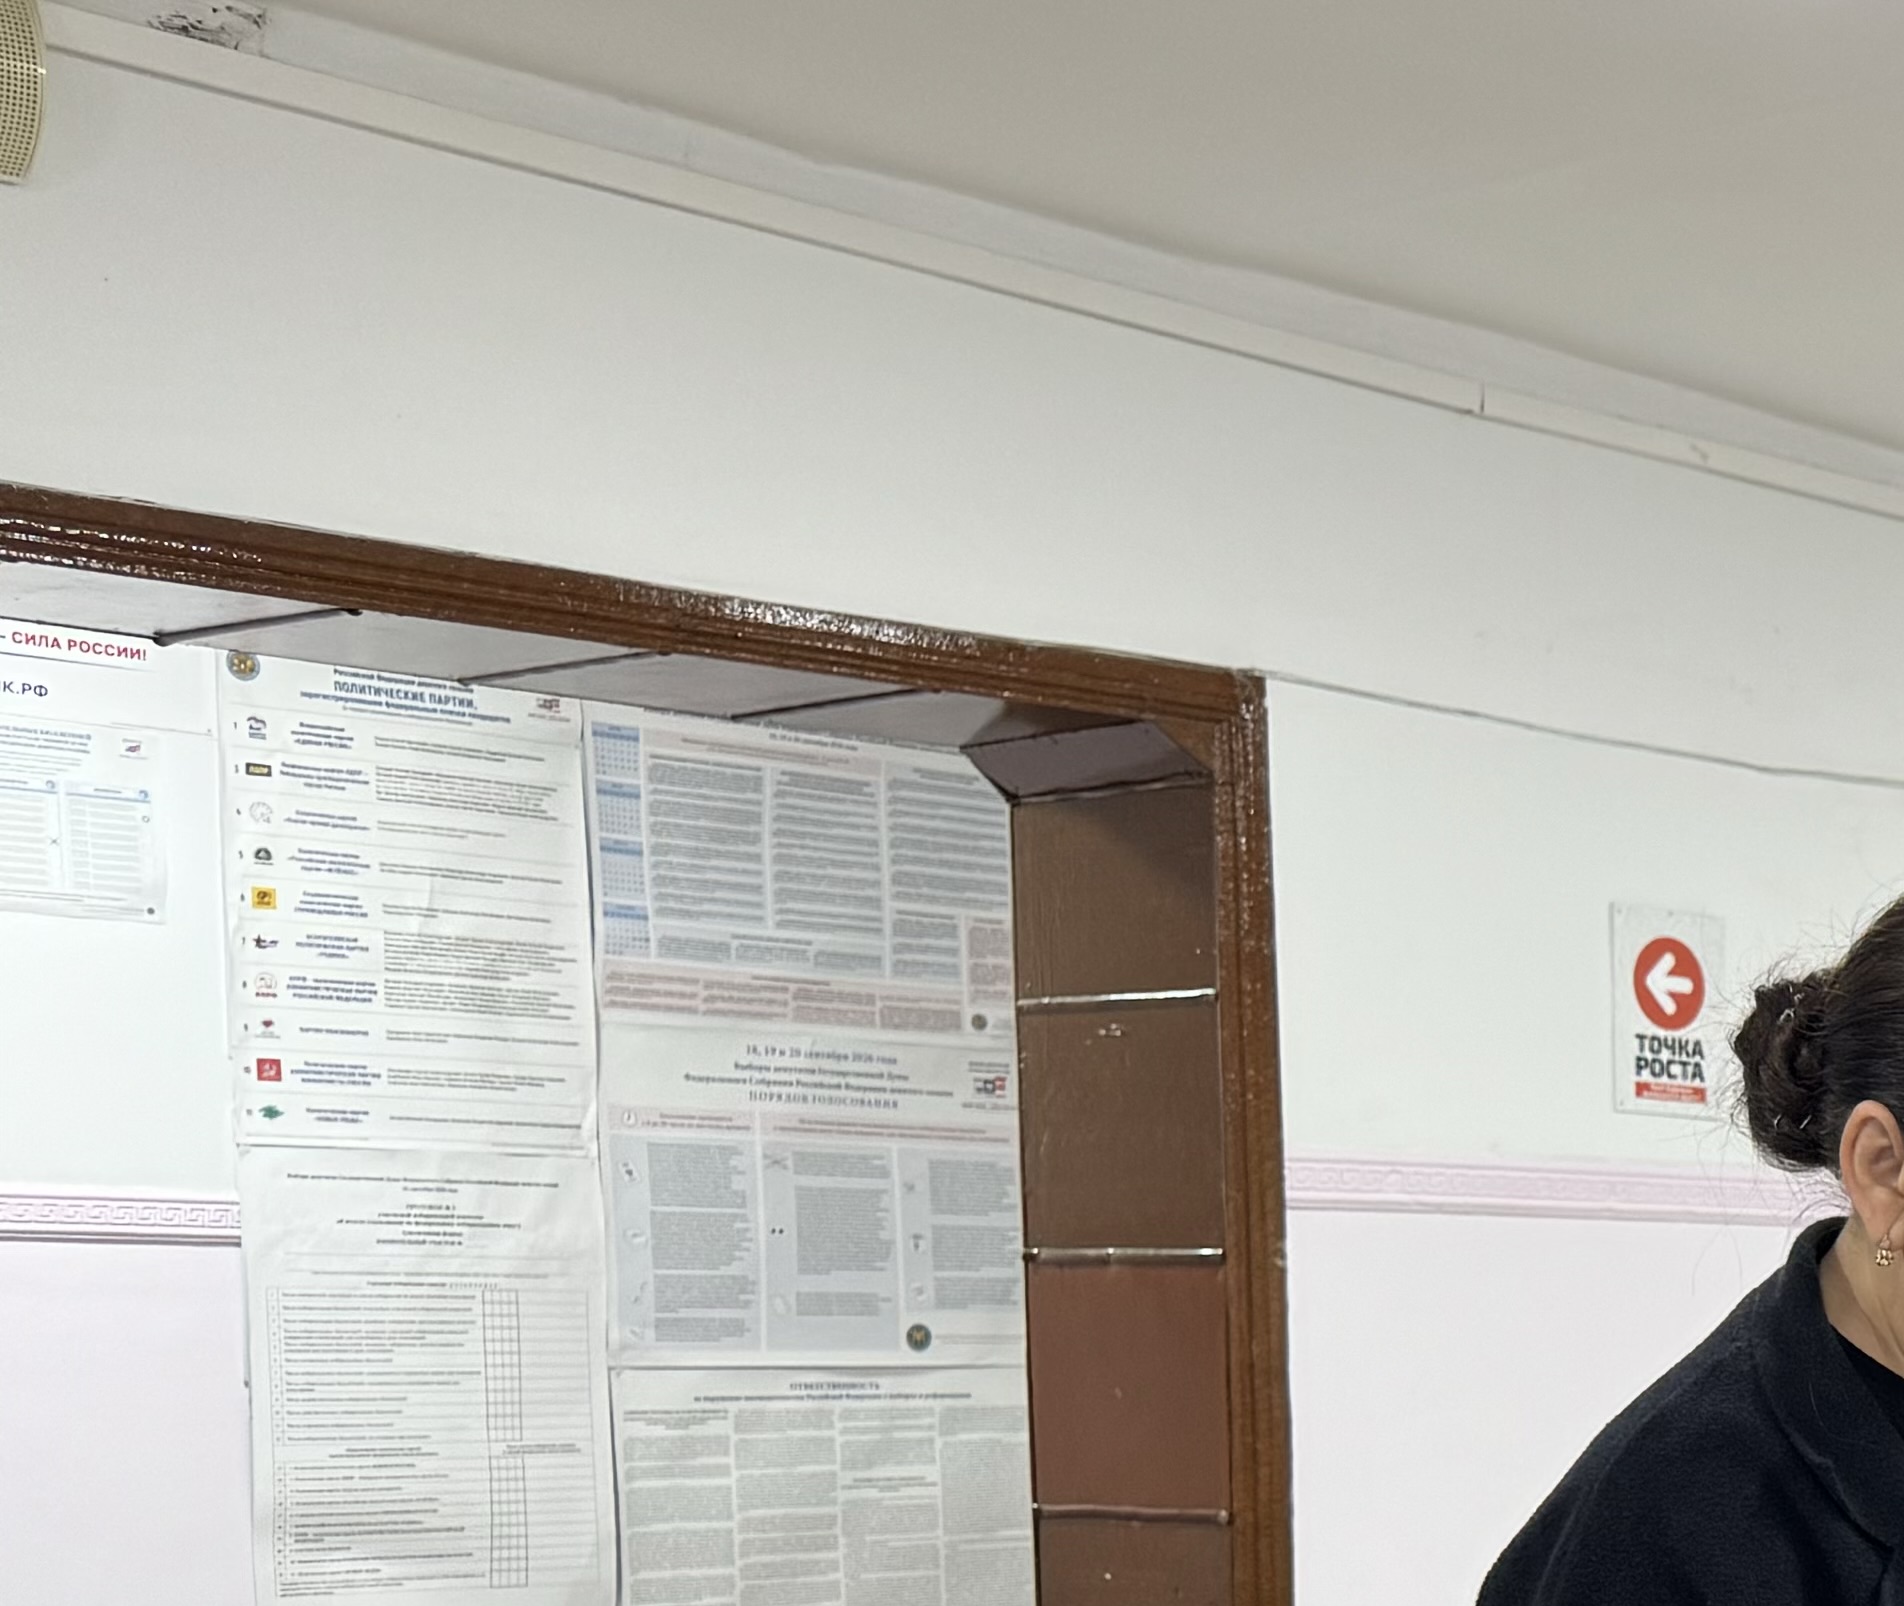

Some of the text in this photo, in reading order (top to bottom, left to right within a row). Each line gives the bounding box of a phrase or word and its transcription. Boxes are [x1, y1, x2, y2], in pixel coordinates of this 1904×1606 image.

[12, 631, 147, 661] СИЛА РОССИИ!
[334, 681, 426, 702] ПОЛИТИЧЕСКИЕ
[1634, 1034, 1705, 1060] ТОЧКА
[1634, 1055, 1705, 1083] РОСТА
